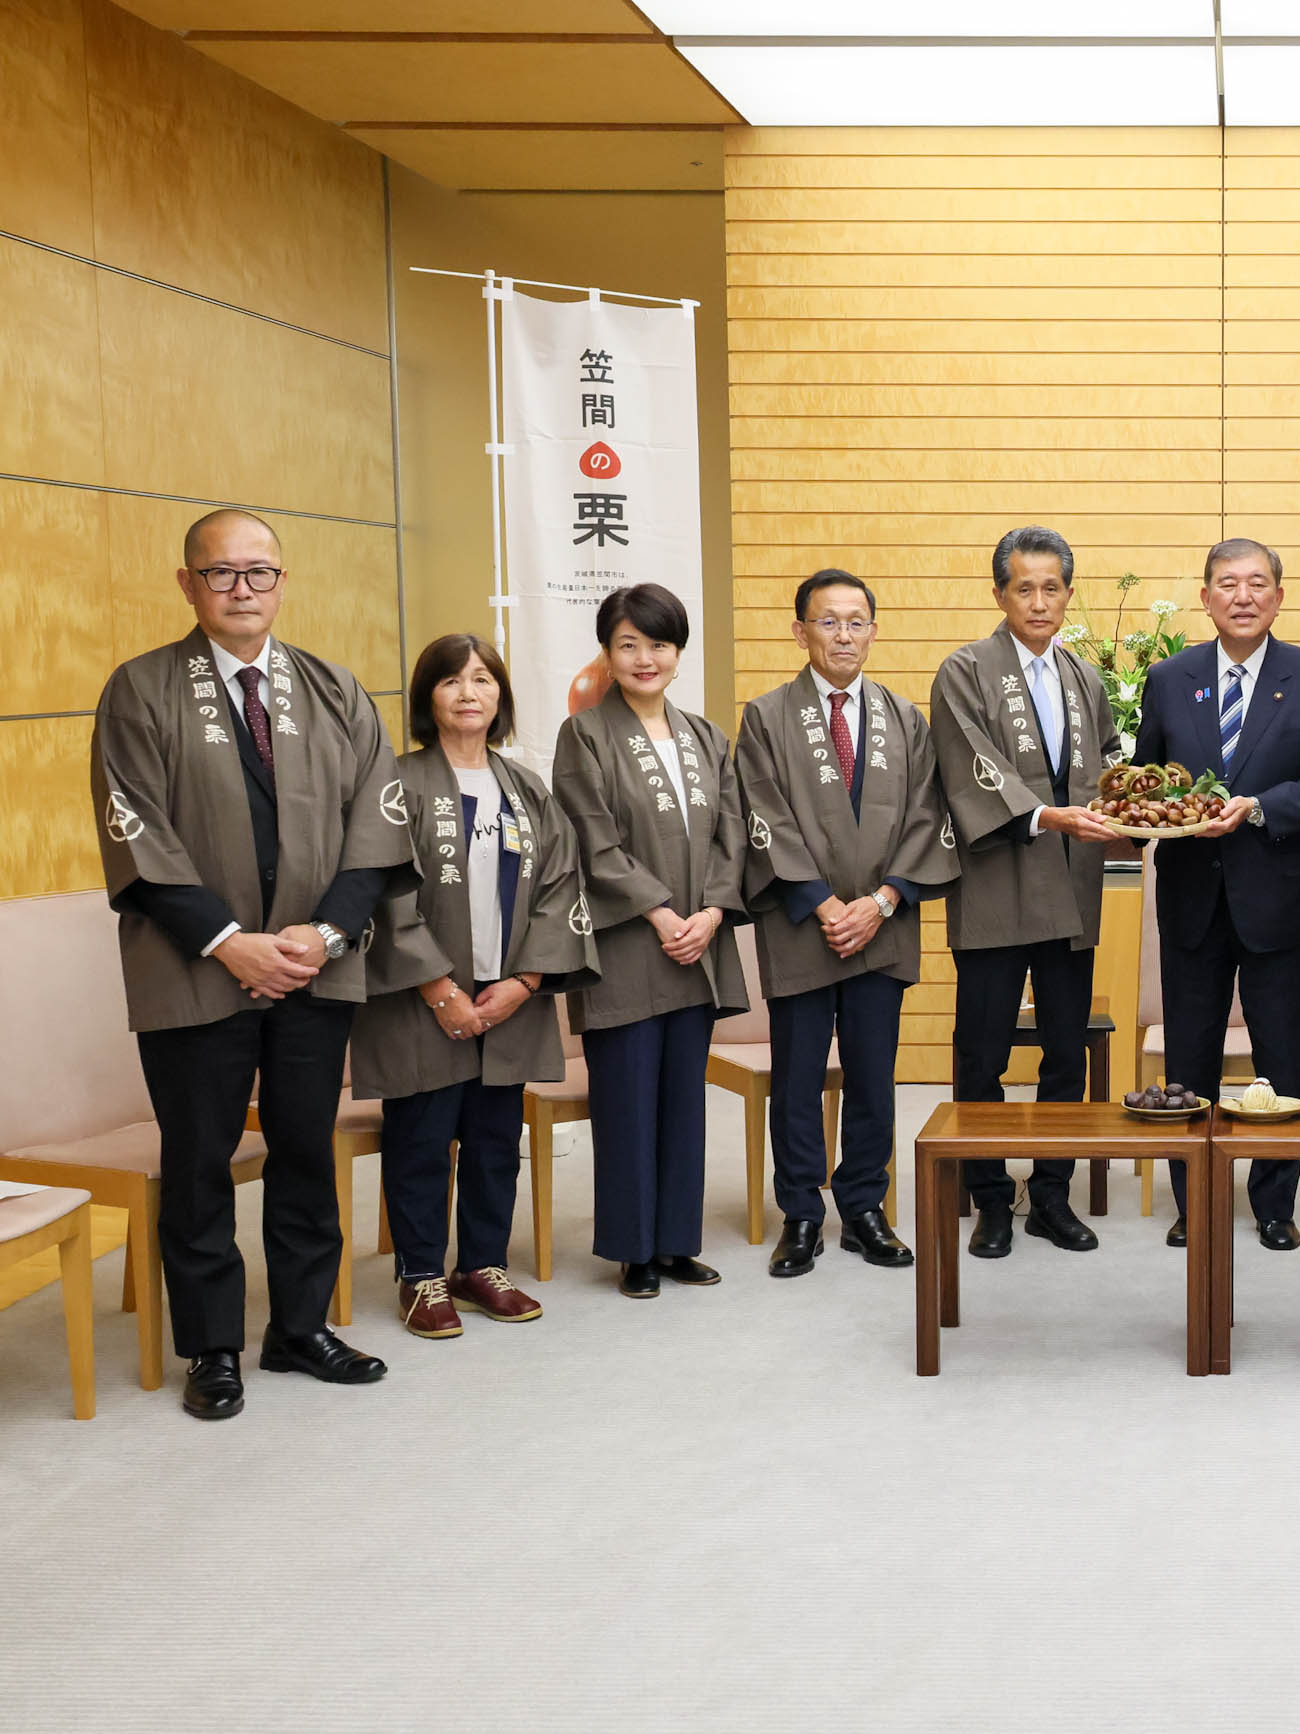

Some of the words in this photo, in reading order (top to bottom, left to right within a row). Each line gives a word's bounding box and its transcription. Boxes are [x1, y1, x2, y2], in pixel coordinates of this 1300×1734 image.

[573, 348, 629, 547] 笠間の栗
[188, 656, 229, 744] 笠間の栗
[270, 650, 299, 736] 笠間の栗
[1001, 674, 1037, 752] 笠間の栗
[1067, 689, 1083, 768] 笠間の栗
[628, 735, 676, 812] 笠間の栗
[678, 731, 707, 806] 笠間の栗
[800, 706, 839, 784] 笠間の栗
[434, 796, 462, 885] 笠間の栗
